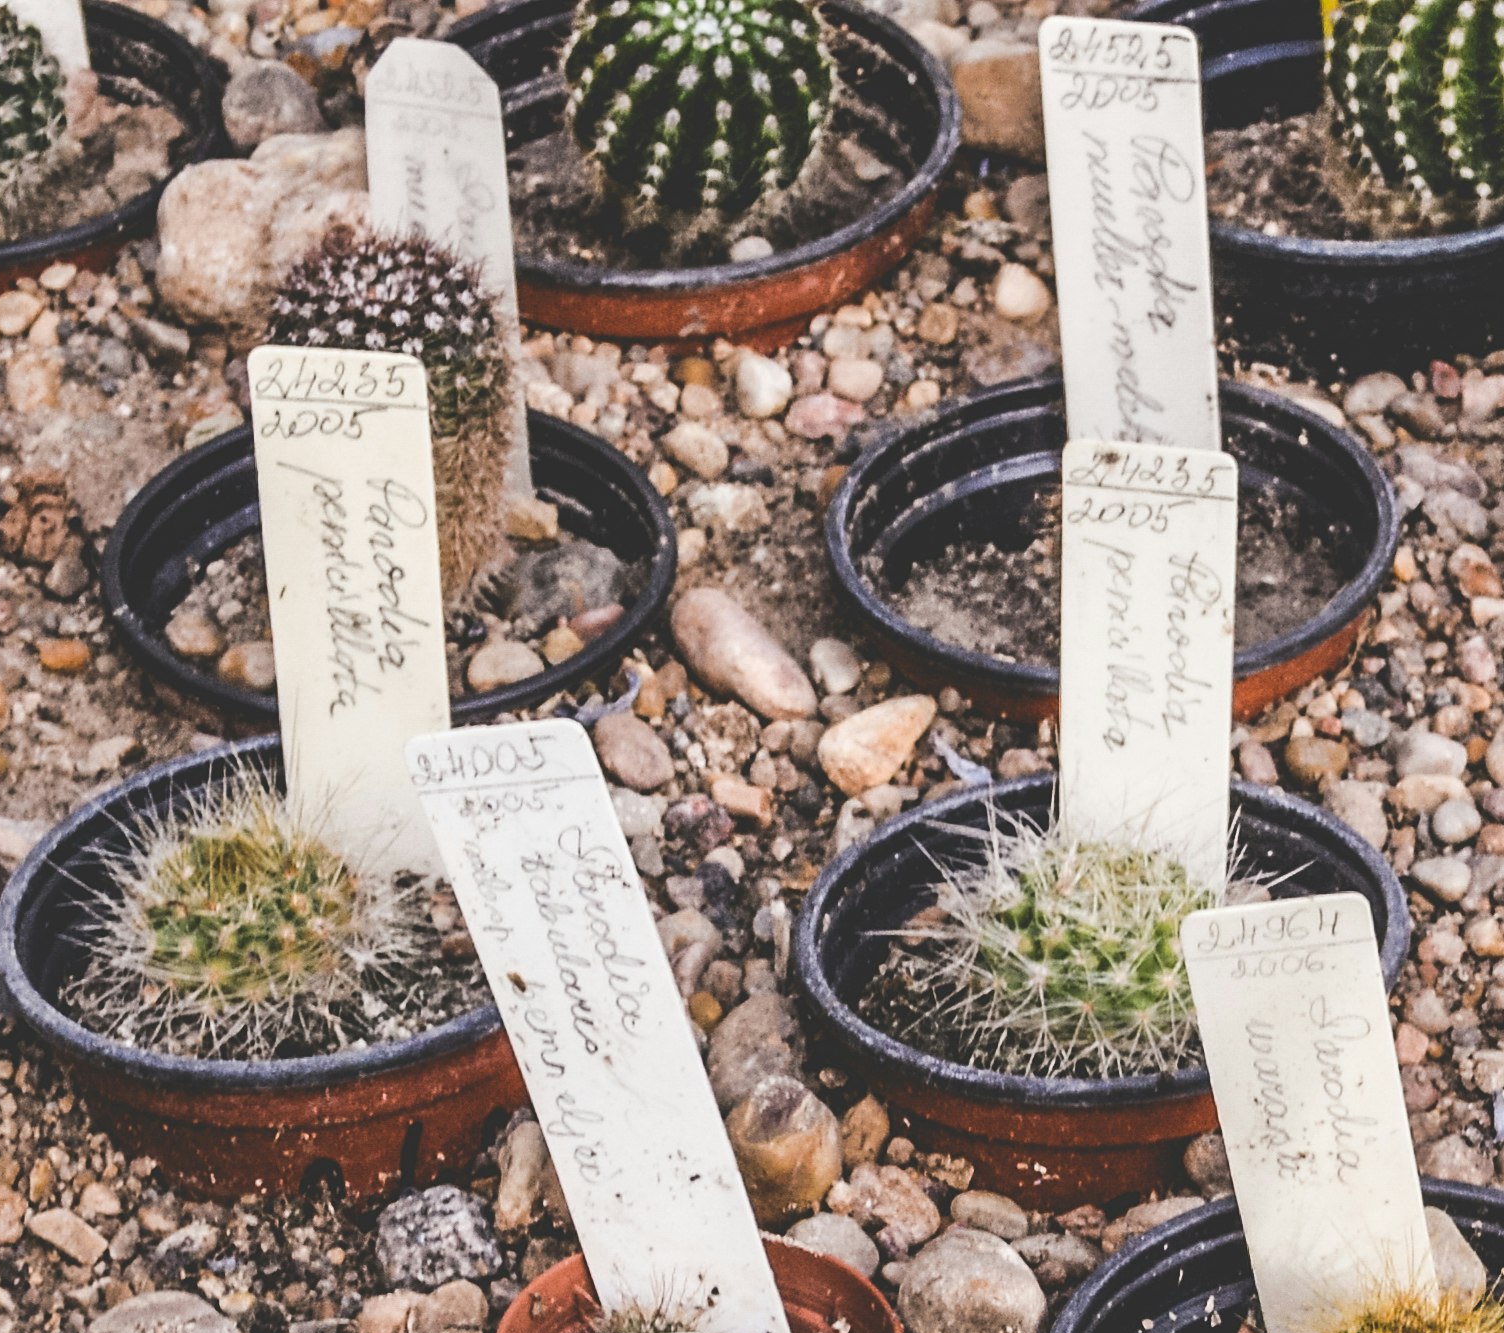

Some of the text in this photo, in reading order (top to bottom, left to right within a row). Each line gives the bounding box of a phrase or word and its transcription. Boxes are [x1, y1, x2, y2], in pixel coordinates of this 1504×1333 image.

[1046, 24, 1191, 71] 24525
[1054, 69, 1161, 114] 2005
[1128, 136, 1200, 335] Parodia
[253, 354, 422, 403] 24235
[258, 404, 390, 441] 2005
[1066, 448, 1235, 503] 24235
[1064, 495, 1197, 535] 2005
[364, 476, 432, 674] Parodia
[1160, 549, 1224, 739] Parodia
[409, 732, 557, 787] 24005
[518, 850, 612, 1057] tabularis
[555, 820, 663, 1038] Parodia
[1195, 905, 1341, 953] 24964
[1307, 993, 1380, 1186] Parodia
